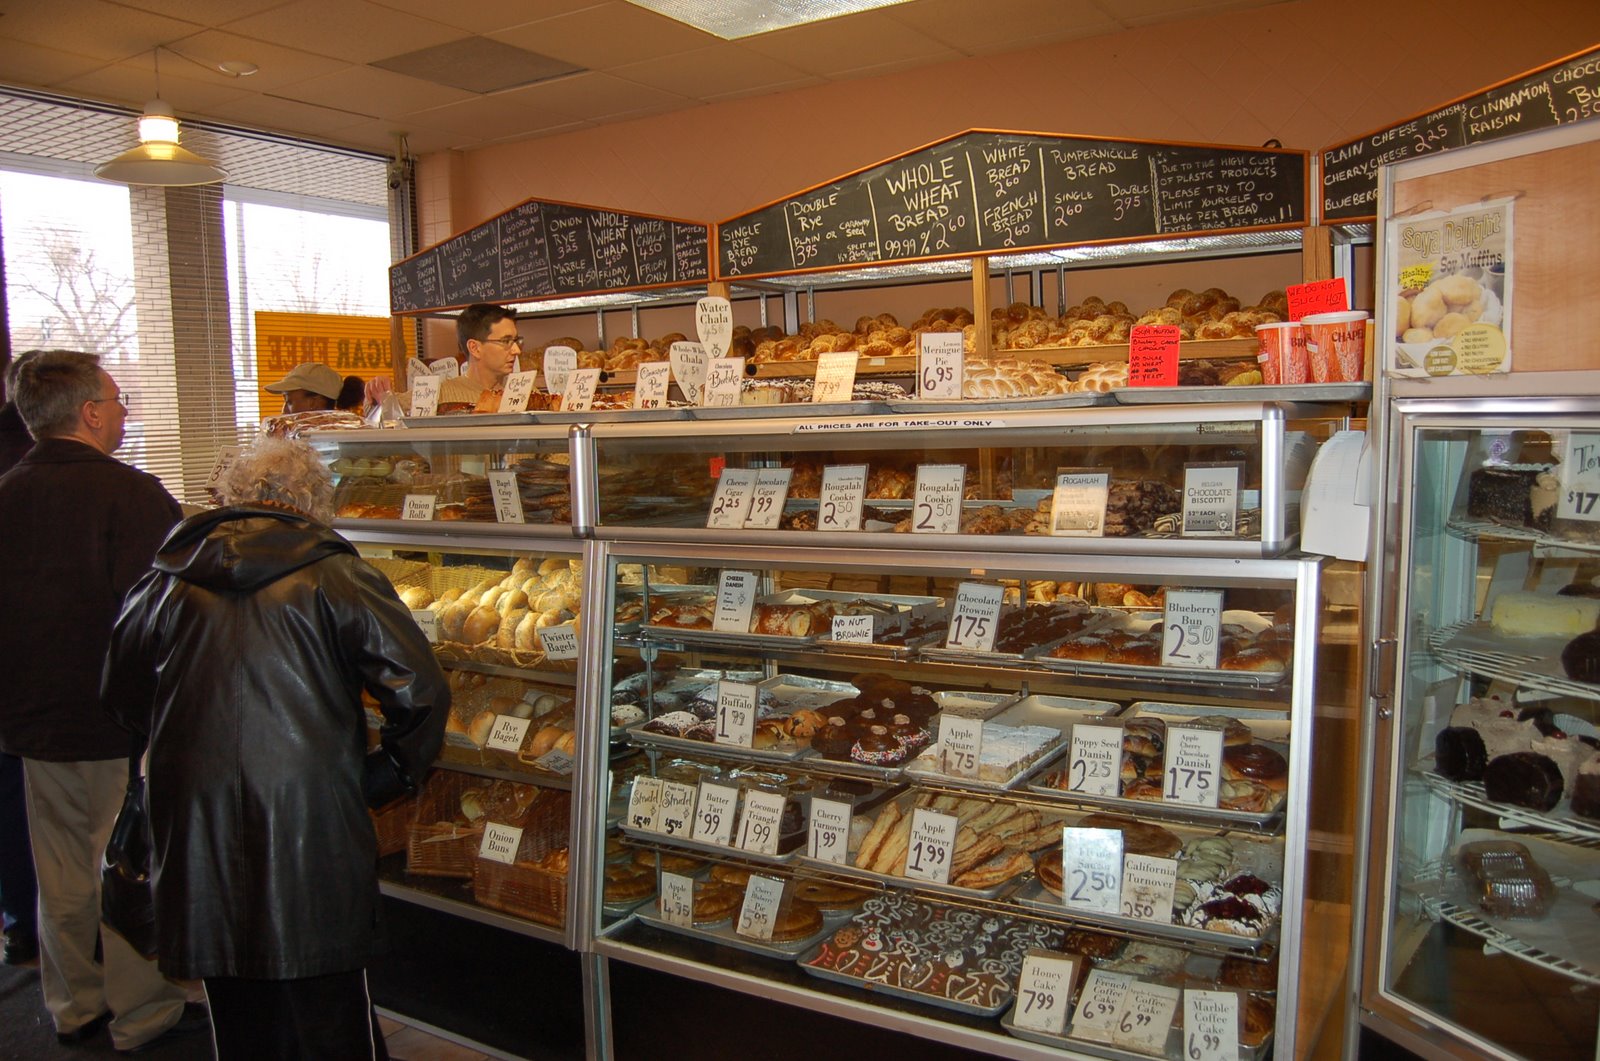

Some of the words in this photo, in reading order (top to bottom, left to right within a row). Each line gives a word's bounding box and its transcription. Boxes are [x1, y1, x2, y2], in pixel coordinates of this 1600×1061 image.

[1469, 81, 1548, 119] CINNAMON
[1470, 112, 1520, 135] RAISIN
[1324, 142, 1364, 166] PLAIN
[1372, 122, 1418, 146] CHEESE
[1427, 104, 1460, 124] DANISH
[983, 145, 1025, 164] WHITE
[1050, 149, 1138, 165] PUMPERNICKLE
[986, 159, 1030, 183] BREAD
[1064, 162, 1116, 180] BREAD
[1163, 165, 1178, 173] DUE
[1221, 157, 1244, 166] HIGH
[1250, 157, 1276, 165] COST
[1324, 162, 1368, 185] CHERRY
[1370, 146, 1407, 168] CHEESE
[886, 157, 954, 195] WHOLE
[1161, 177, 1173, 185] OF
[1221, 167, 1276, 178] PRODUCTS
[904, 181, 962, 212] WHEAT
[1161, 188, 1200, 200] PLEASE
[1206, 184, 1229, 194] TRY
[1237, 181, 1255, 192] TO
[1055, 191, 1093, 203] SINGLE
[1163, 200, 1193, 211] LIMIT
[1201, 194, 1251, 208] YOURSELF
[1257, 192, 1273, 200] TO
[1324, 188, 1378, 211] BLUEBERR
[790, 193, 838, 216] DOUBLE
[984, 190, 1037, 226] FRENCH
[591, 212, 629, 227] WHOLE
[888, 206, 949, 231] BREAD
[1170, 214, 1192, 224] BAG
[1196, 210, 1218, 220] PER
[1222, 203, 1258, 217] BREAD
[550, 217, 582, 232] ONION
[992, 209, 1032, 232] BREAD
[634, 221, 665, 235] WATER
[723, 222, 762, 241] SINGLE
[1164, 223, 1193, 233] EXTRA
[1201, 221, 1226, 229] BAGS
[552, 231, 576, 245] RYE
[594, 228, 626, 245] WHEAT
[636, 232, 666, 247] CHALA
[793, 233, 820, 247] PLAIN
[826, 231, 837, 240] OR
[1402, 227, 1440, 258] Soya
[1444, 213, 1500, 255] Delight
[732, 237, 749, 250] RYE
[596, 243, 628, 258] CHALA
[727, 246, 757, 261] BREAD
[1461, 249, 1502, 269] Muffins
[553, 260, 585, 276] MARBLE
[599, 266, 628, 278] FRIDAY
[640, 258, 666, 276] FRIDAY
[558, 277, 575, 286] RYE
[605, 275, 630, 288] ONLY
[645, 272, 668, 284] ONLY
[1288, 287, 1300, 296] WE
[700, 303, 729, 312] Water
[700, 314, 728, 324] Chala
[923, 346, 960, 356] Meringue
[680, 354, 703, 364] Chala
[935, 357, 948, 365] Pie
[756, 478, 786, 486] hocolate
[825, 482, 861, 492] Rougalah
[726, 489, 743, 497] Cigar
[758, 488, 776, 496] Cigar
[920, 483, 960, 494] Rougalah
[1188, 488, 1232, 496] CHOCOLATE
[409, 500, 429, 509] Onion
[925, 494, 954, 503] Cookie
[409, 510, 425, 519] Rolls
[958, 593, 1000, 606] Chocolate
[959, 604, 994, 616] Brownie
[1169, 603, 1218, 616] Blueberry
[834, 620, 846, 628] NO
[848, 618, 866, 626] NUT
[1182, 616, 1202, 626] Bun
[540, 632, 574, 642] Twister
[835, 629, 870, 640] BROWNIE
[547, 642, 577, 654] Bagels
[722, 696, 752, 709] Buffalo
[502, 722, 518, 732] Rye
[493, 731, 519, 743] Bagels
[949, 728, 973, 740] Apple
[1182, 734, 1199, 742] Apple
[945, 739, 974, 750] Square
[1074, 737, 1098, 749] Poppy
[1101, 739, 1119, 748] Seed
[1079, 749, 1112, 760] Danish
[1180, 750, 1209, 758] Chocolate
[1175, 757, 1211, 768] Danish
[706, 793, 729, 804] Butter
[708, 804, 723, 814] Tart
[751, 801, 779, 814] Coconut
[748, 811, 777, 825] Triangle
[817, 809, 843, 822] Cherry
[812, 819, 845, 833] Turnover
[921, 822, 945, 834] Apple
[489, 829, 514, 844] Onion
[913, 831, 950, 847] Turnover
[487, 841, 509, 854] Buns
[1126, 861, 1175, 876] California
[1126, 873, 1173, 888] Turnover
[669, 882, 686, 892] Apple
[754, 902, 765, 911] Pie
[1032, 967, 1062, 982] Honey
[1034, 980, 1056, 991] Cake
[1095, 978, 1127, 990] French
[1093, 986, 1122, 997] Coffee
[1093, 994, 1117, 1004] Cake
[1136, 996, 1166, 1007] Coffee
[1137, 1004, 1161, 1015] Cake
[1194, 1001, 1229, 1013] Marble
[1195, 1013, 1227, 1023] Coffee
[1198, 1023, 1224, 1034] Cake
